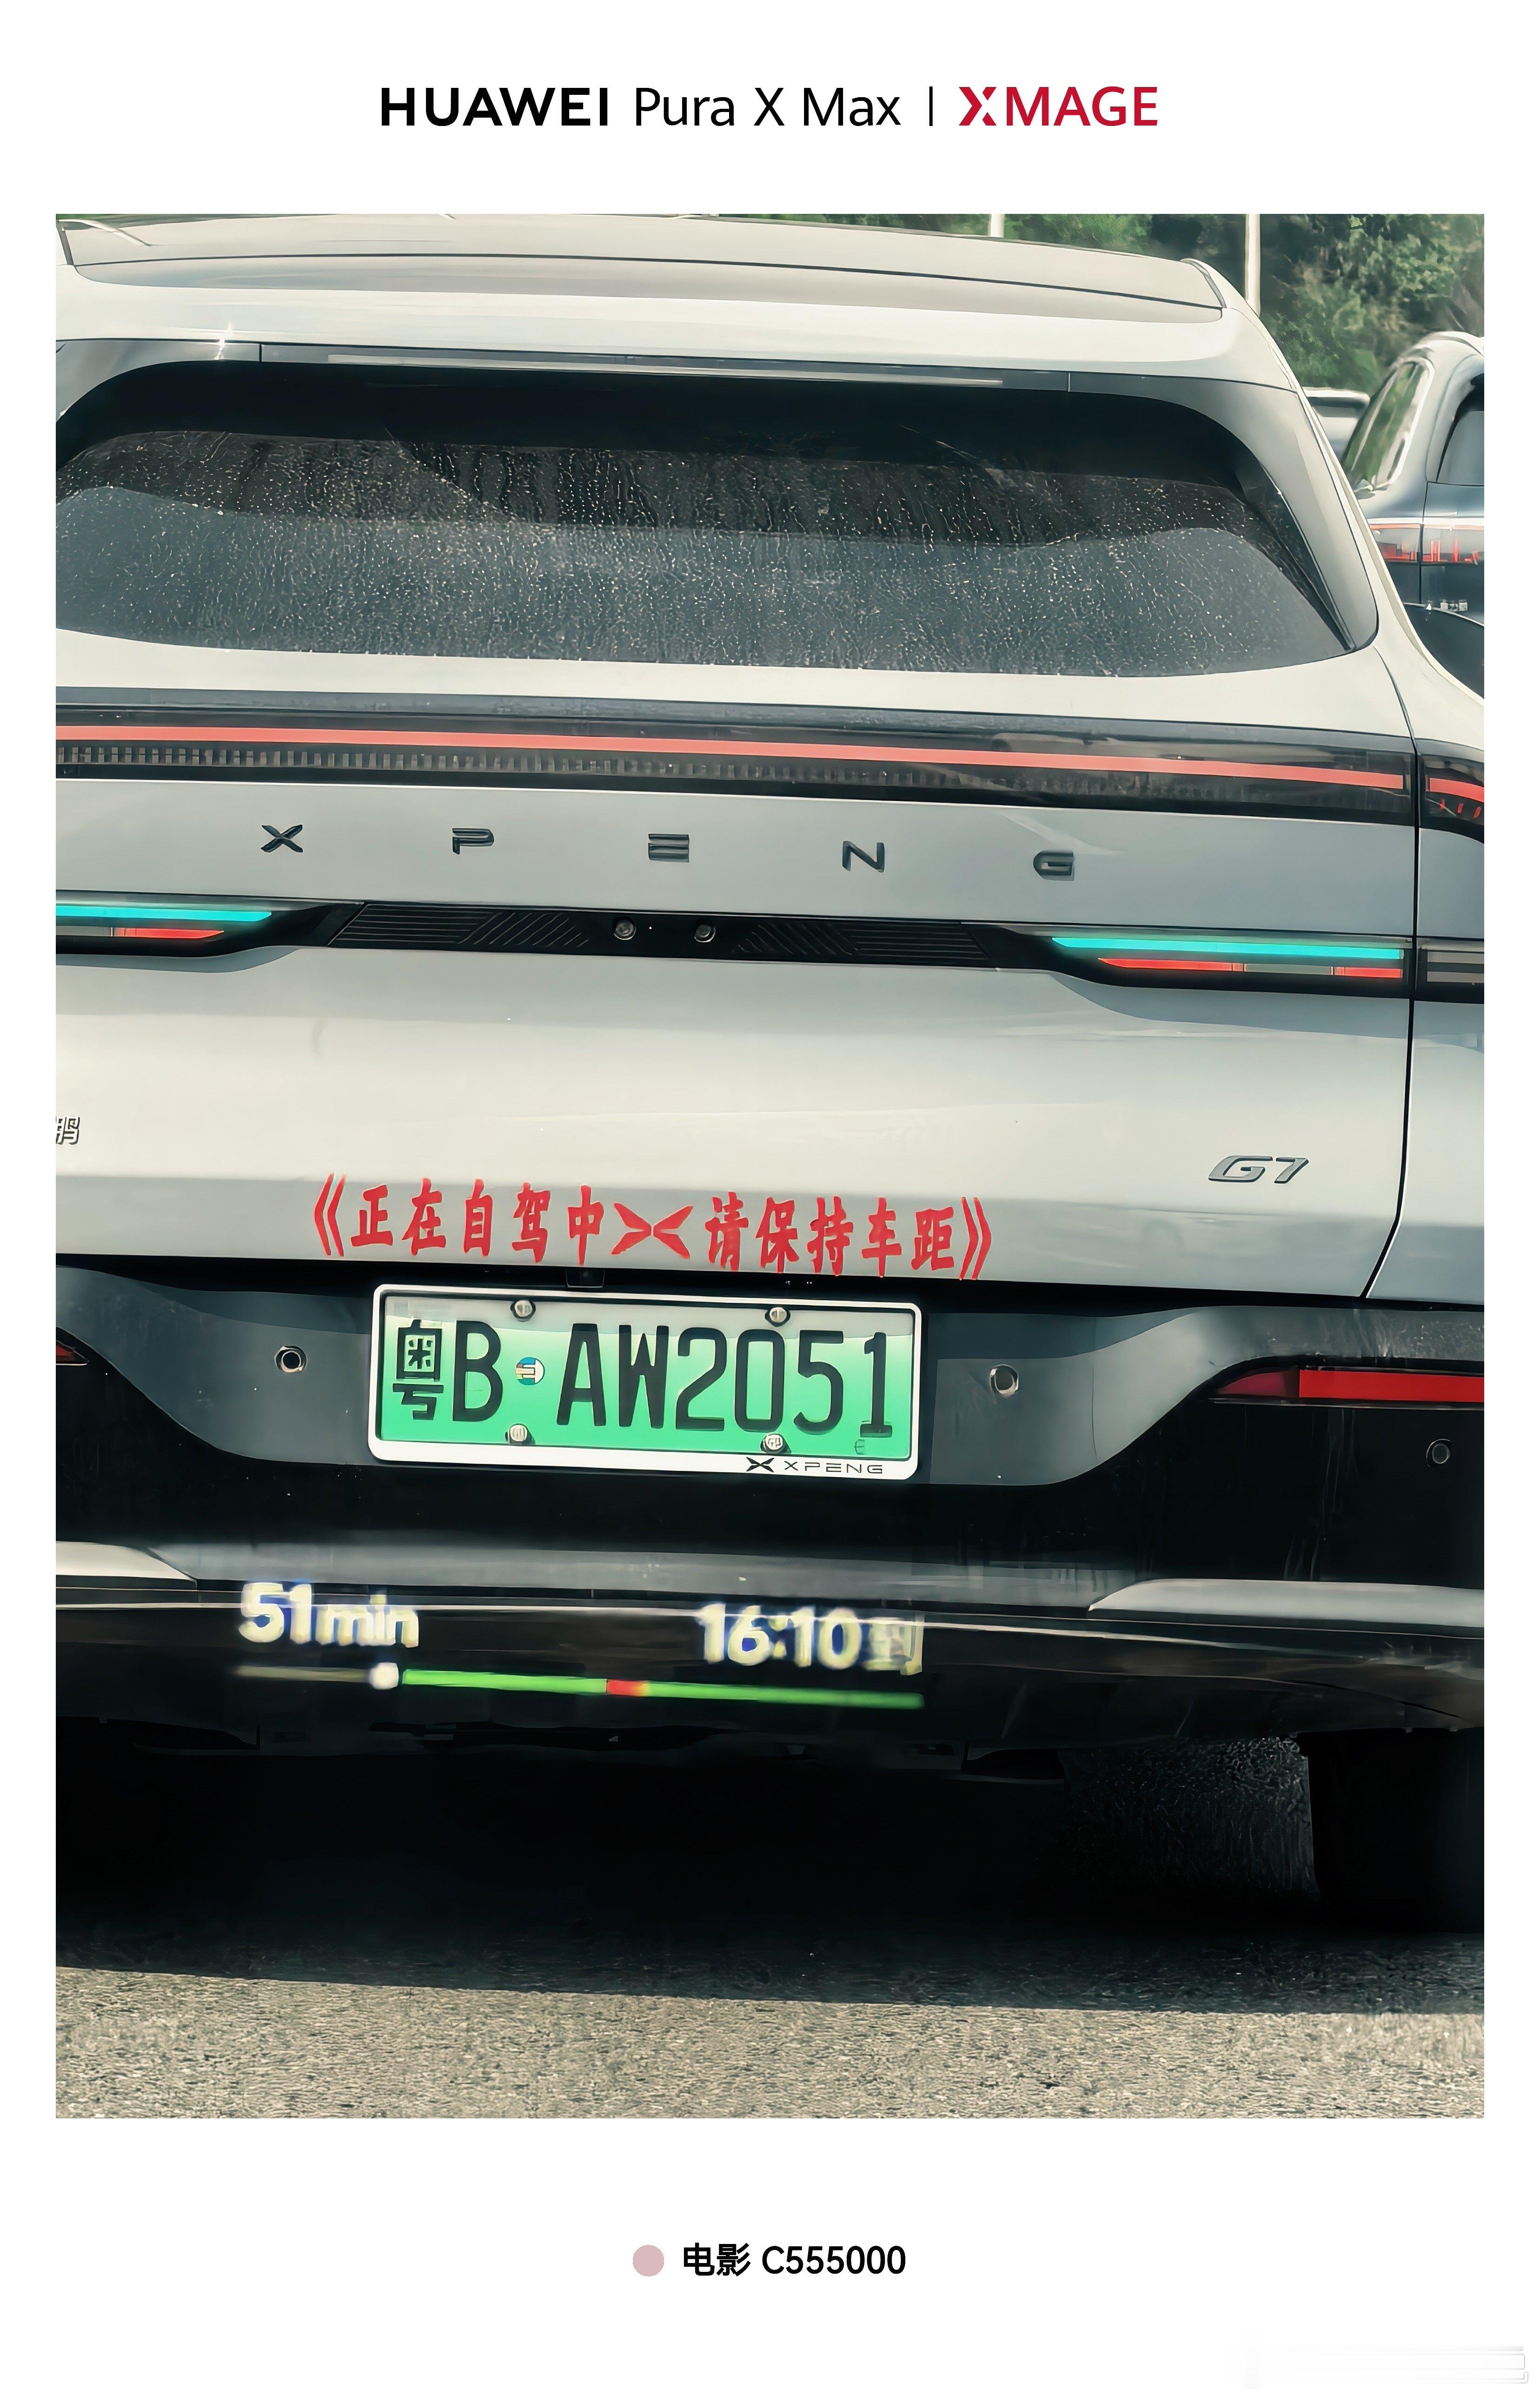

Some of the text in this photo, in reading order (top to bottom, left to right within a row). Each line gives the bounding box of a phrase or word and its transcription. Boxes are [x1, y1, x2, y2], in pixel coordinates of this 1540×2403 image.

[261, 824, 1075, 882] XPENG
[1208, 1155, 1309, 1184] G7
[557, 1323, 892, 1438] AW2051
[784, 1460, 883, 1474] XPENG
